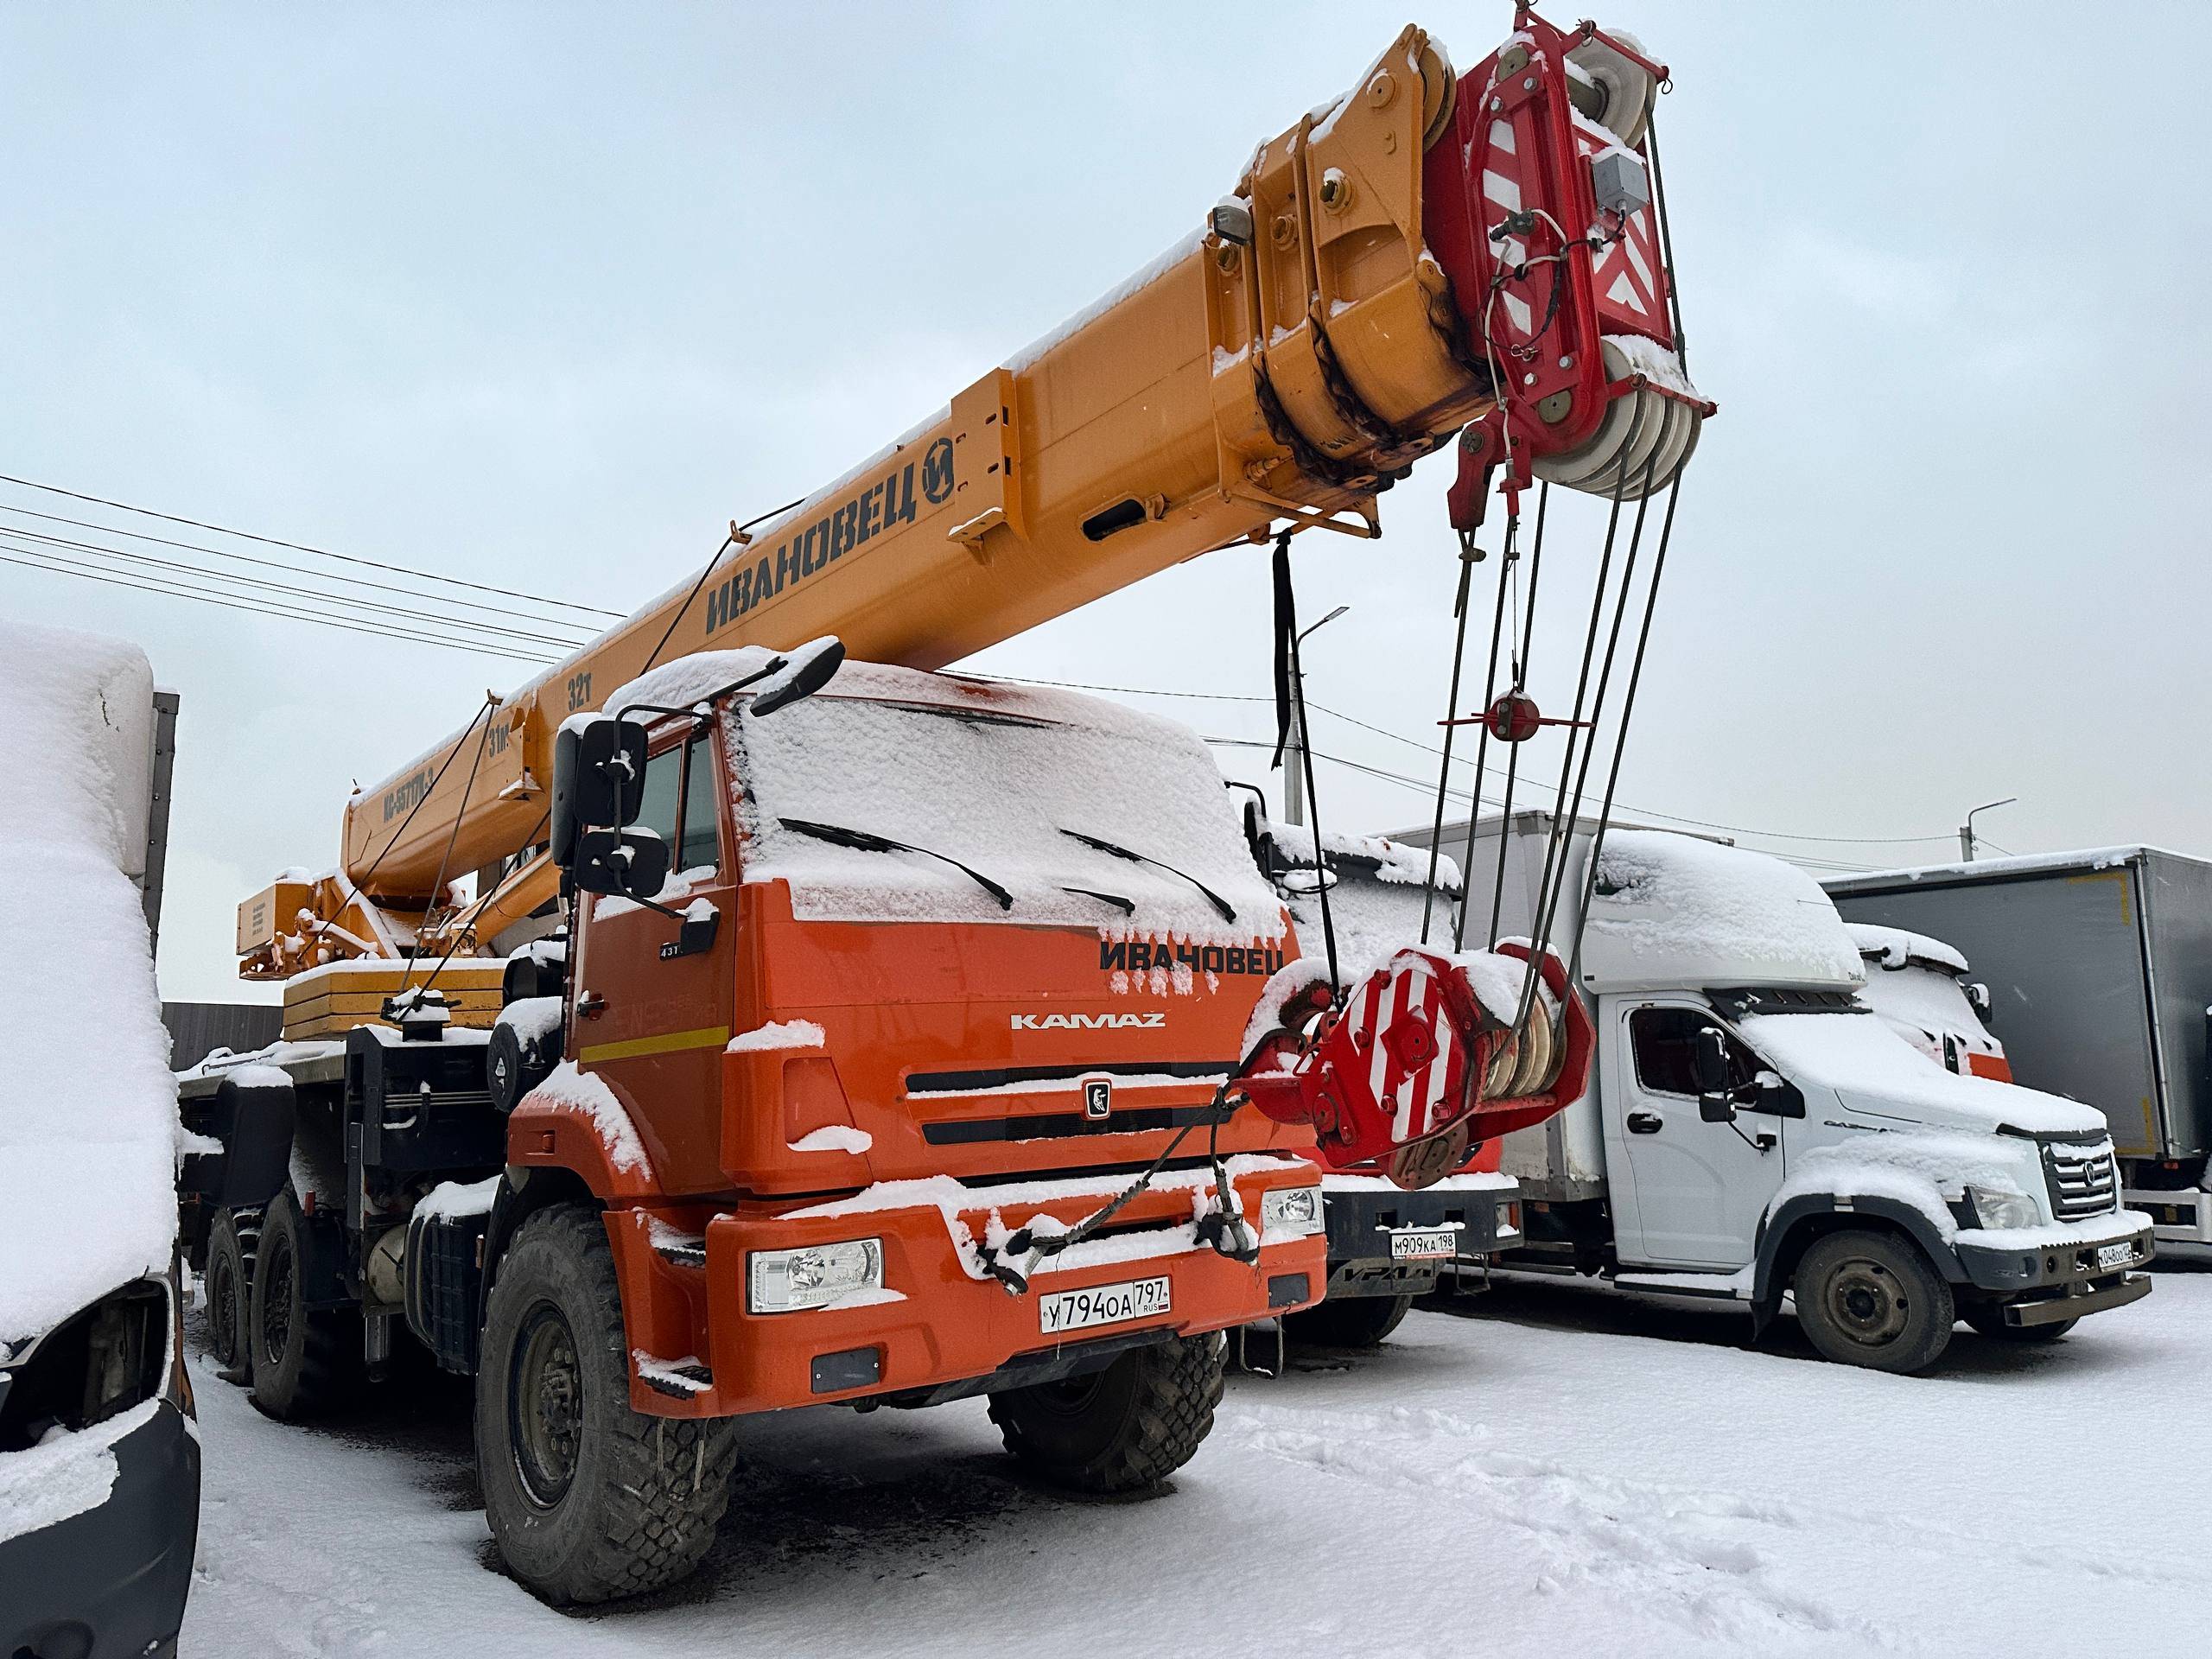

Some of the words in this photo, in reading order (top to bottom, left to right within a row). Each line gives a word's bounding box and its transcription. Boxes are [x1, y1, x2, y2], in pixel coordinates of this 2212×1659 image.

[706, 462, 917, 635] ИВАНОВЕЦ
[1010, 1013, 1166, 1030] KAMAZ
[1438, 1235, 1453, 1247] 198
[1135, 1281, 1163, 1305] 797
[1143, 1303, 1159, 1313] RUS
